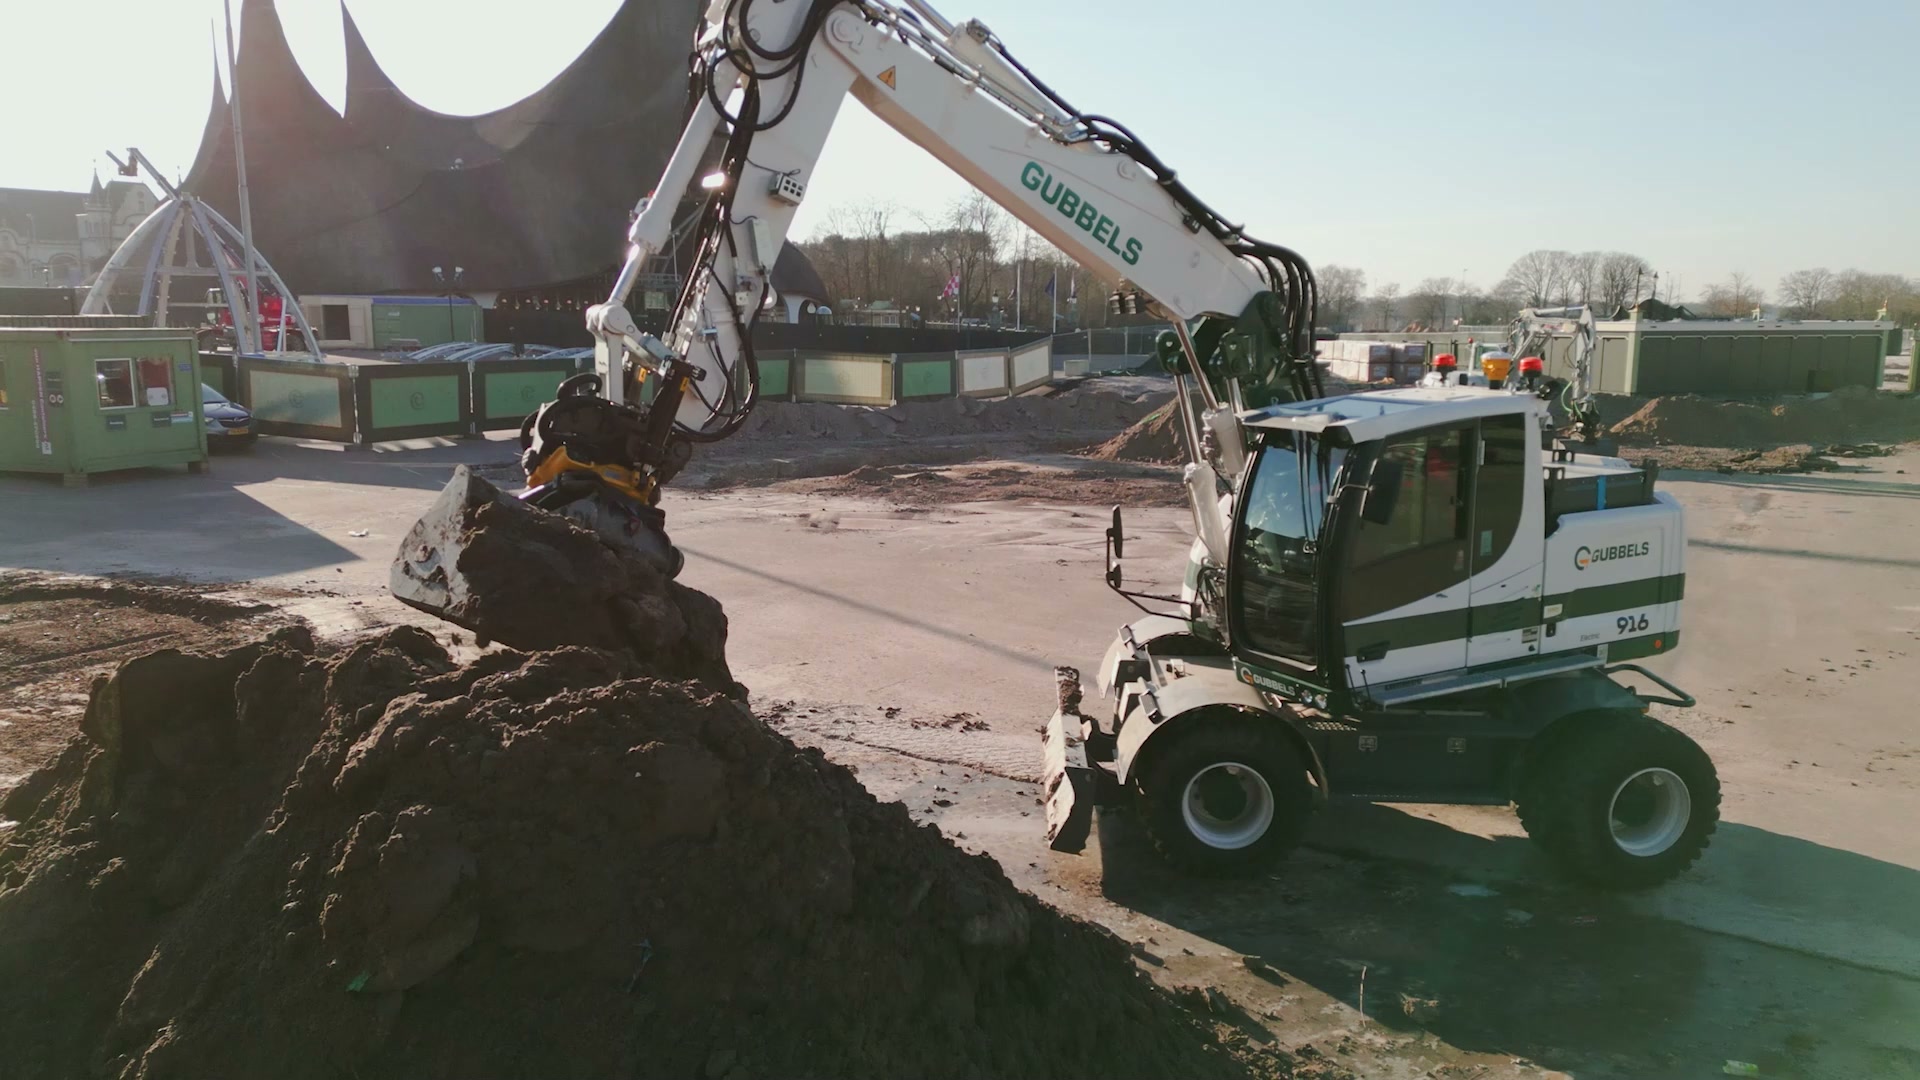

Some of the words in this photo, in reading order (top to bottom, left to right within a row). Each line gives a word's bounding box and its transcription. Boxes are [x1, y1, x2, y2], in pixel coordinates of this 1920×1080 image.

[1020, 161, 1143, 266] GUBBELS
[1591, 541, 1649, 563] GUBBELS
[1616, 613, 1649, 635] 916
[1252, 675, 1296, 696] GUBBELS
